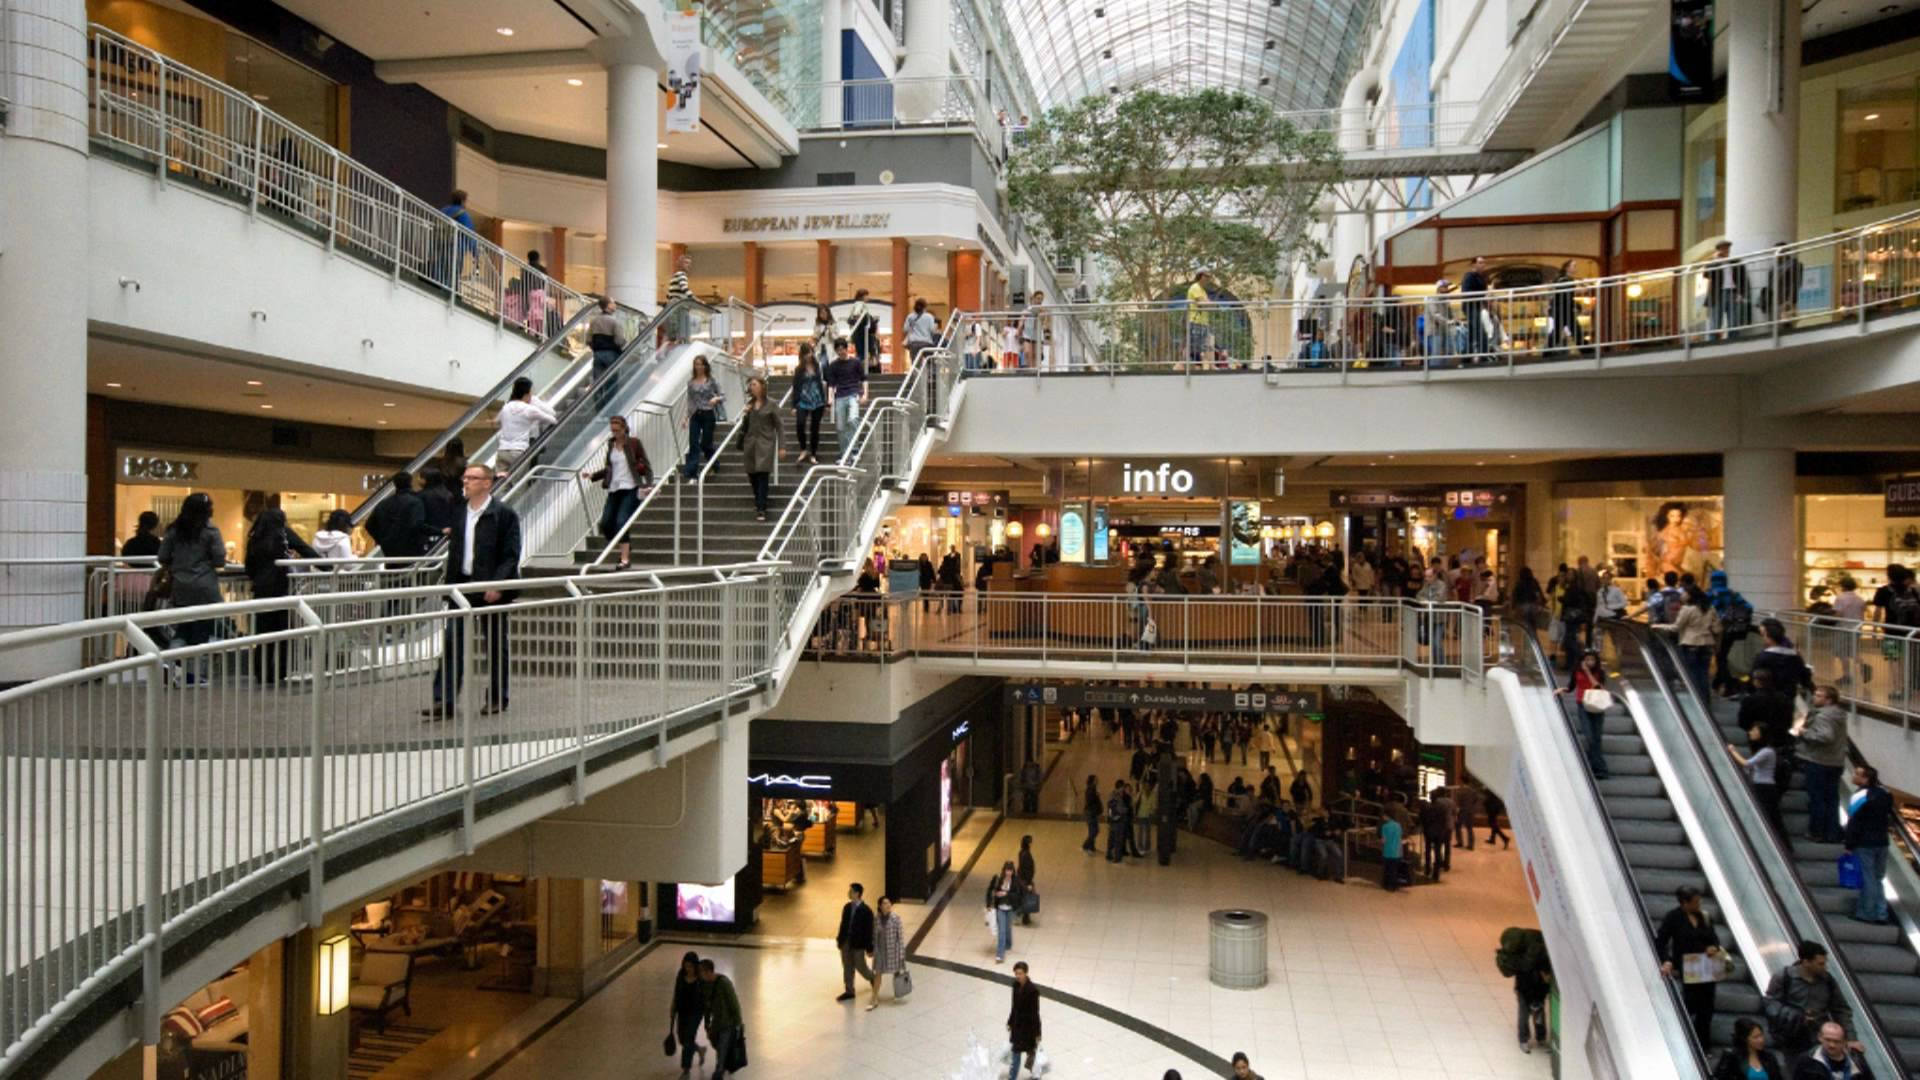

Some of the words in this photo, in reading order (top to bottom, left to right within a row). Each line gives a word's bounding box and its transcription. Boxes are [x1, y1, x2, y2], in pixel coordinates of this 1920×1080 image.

[723, 215, 799, 232] EUROPEAN
[803, 213, 890, 230] JEWELLERY
[1123, 463, 1194, 492] info
[1144, 694, 1177, 704] Dundas
[1178, 695, 1207, 705] Street
